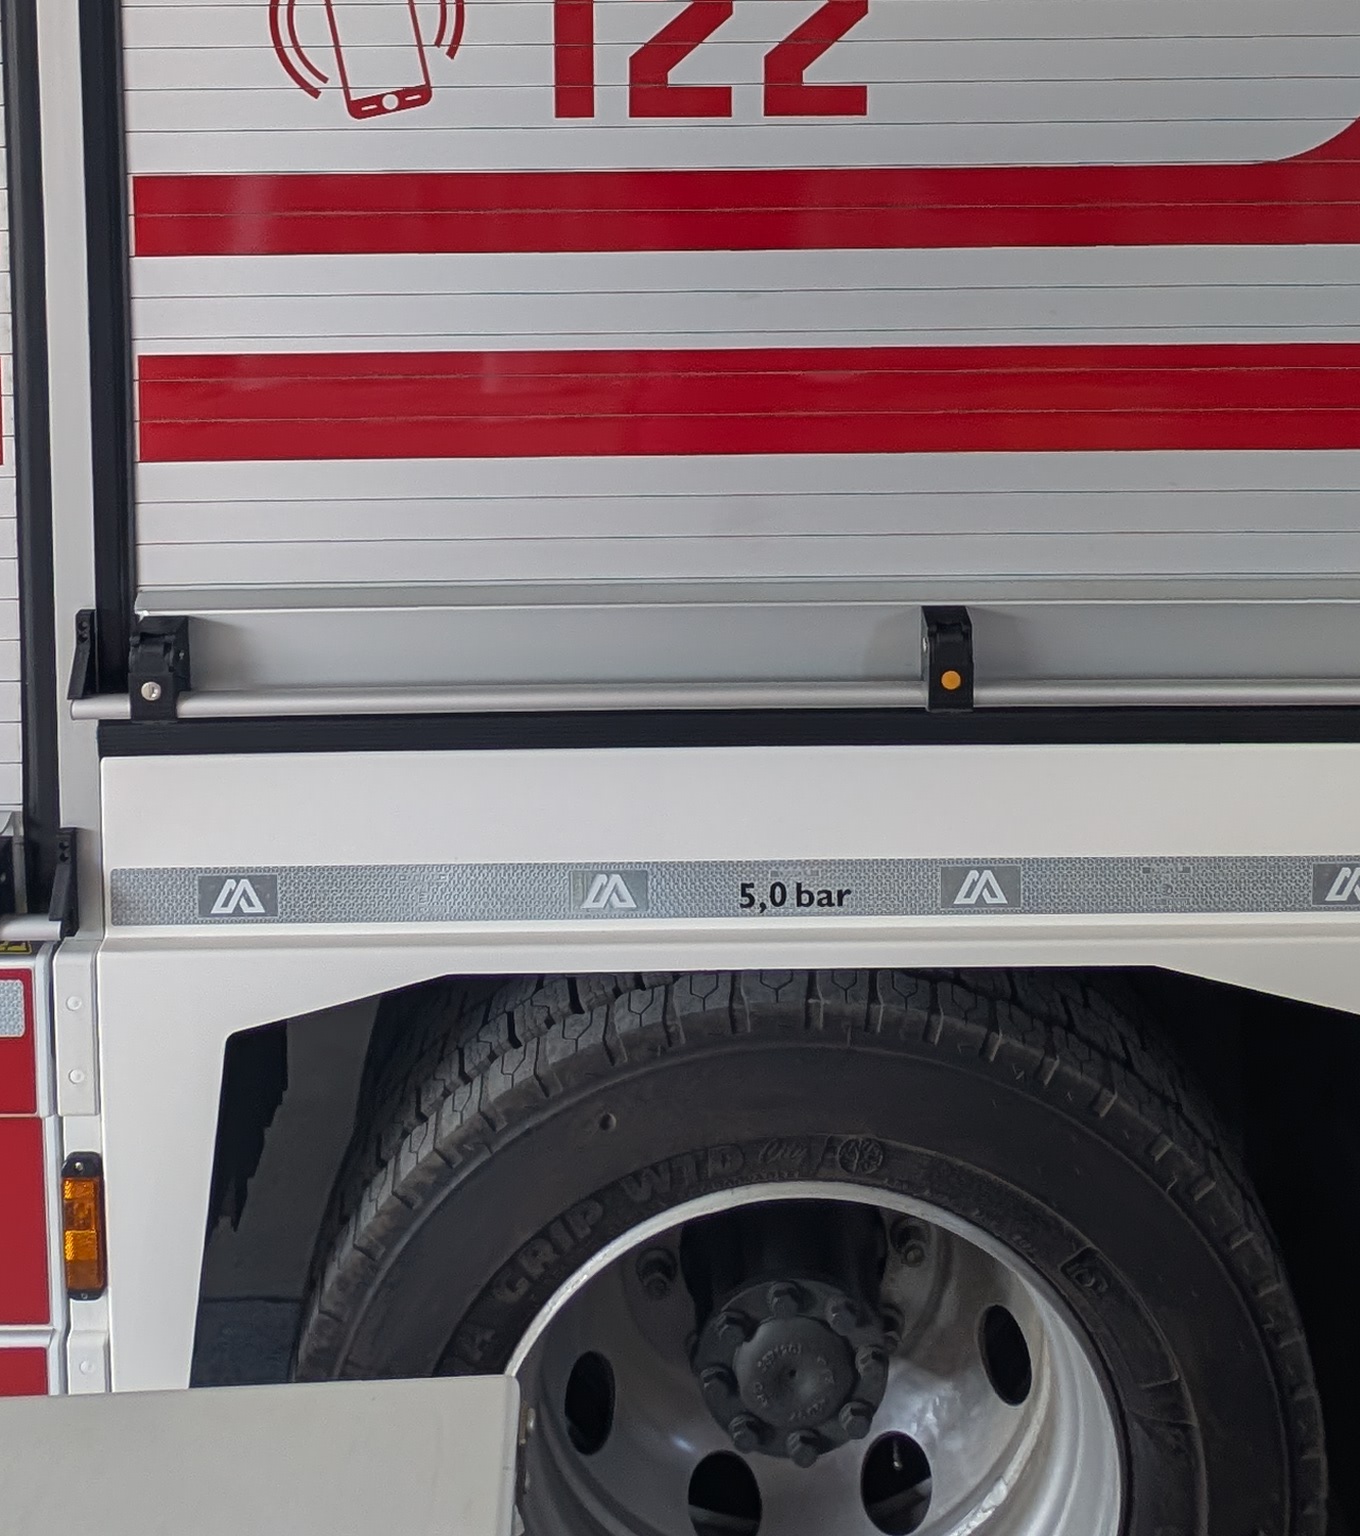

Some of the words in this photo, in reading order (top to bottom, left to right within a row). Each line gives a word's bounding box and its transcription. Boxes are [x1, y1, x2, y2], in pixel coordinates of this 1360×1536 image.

[740, 881, 788, 914] 5,0
[796, 882, 852, 908] bar
[492, 1199, 603, 1304] GRIP
